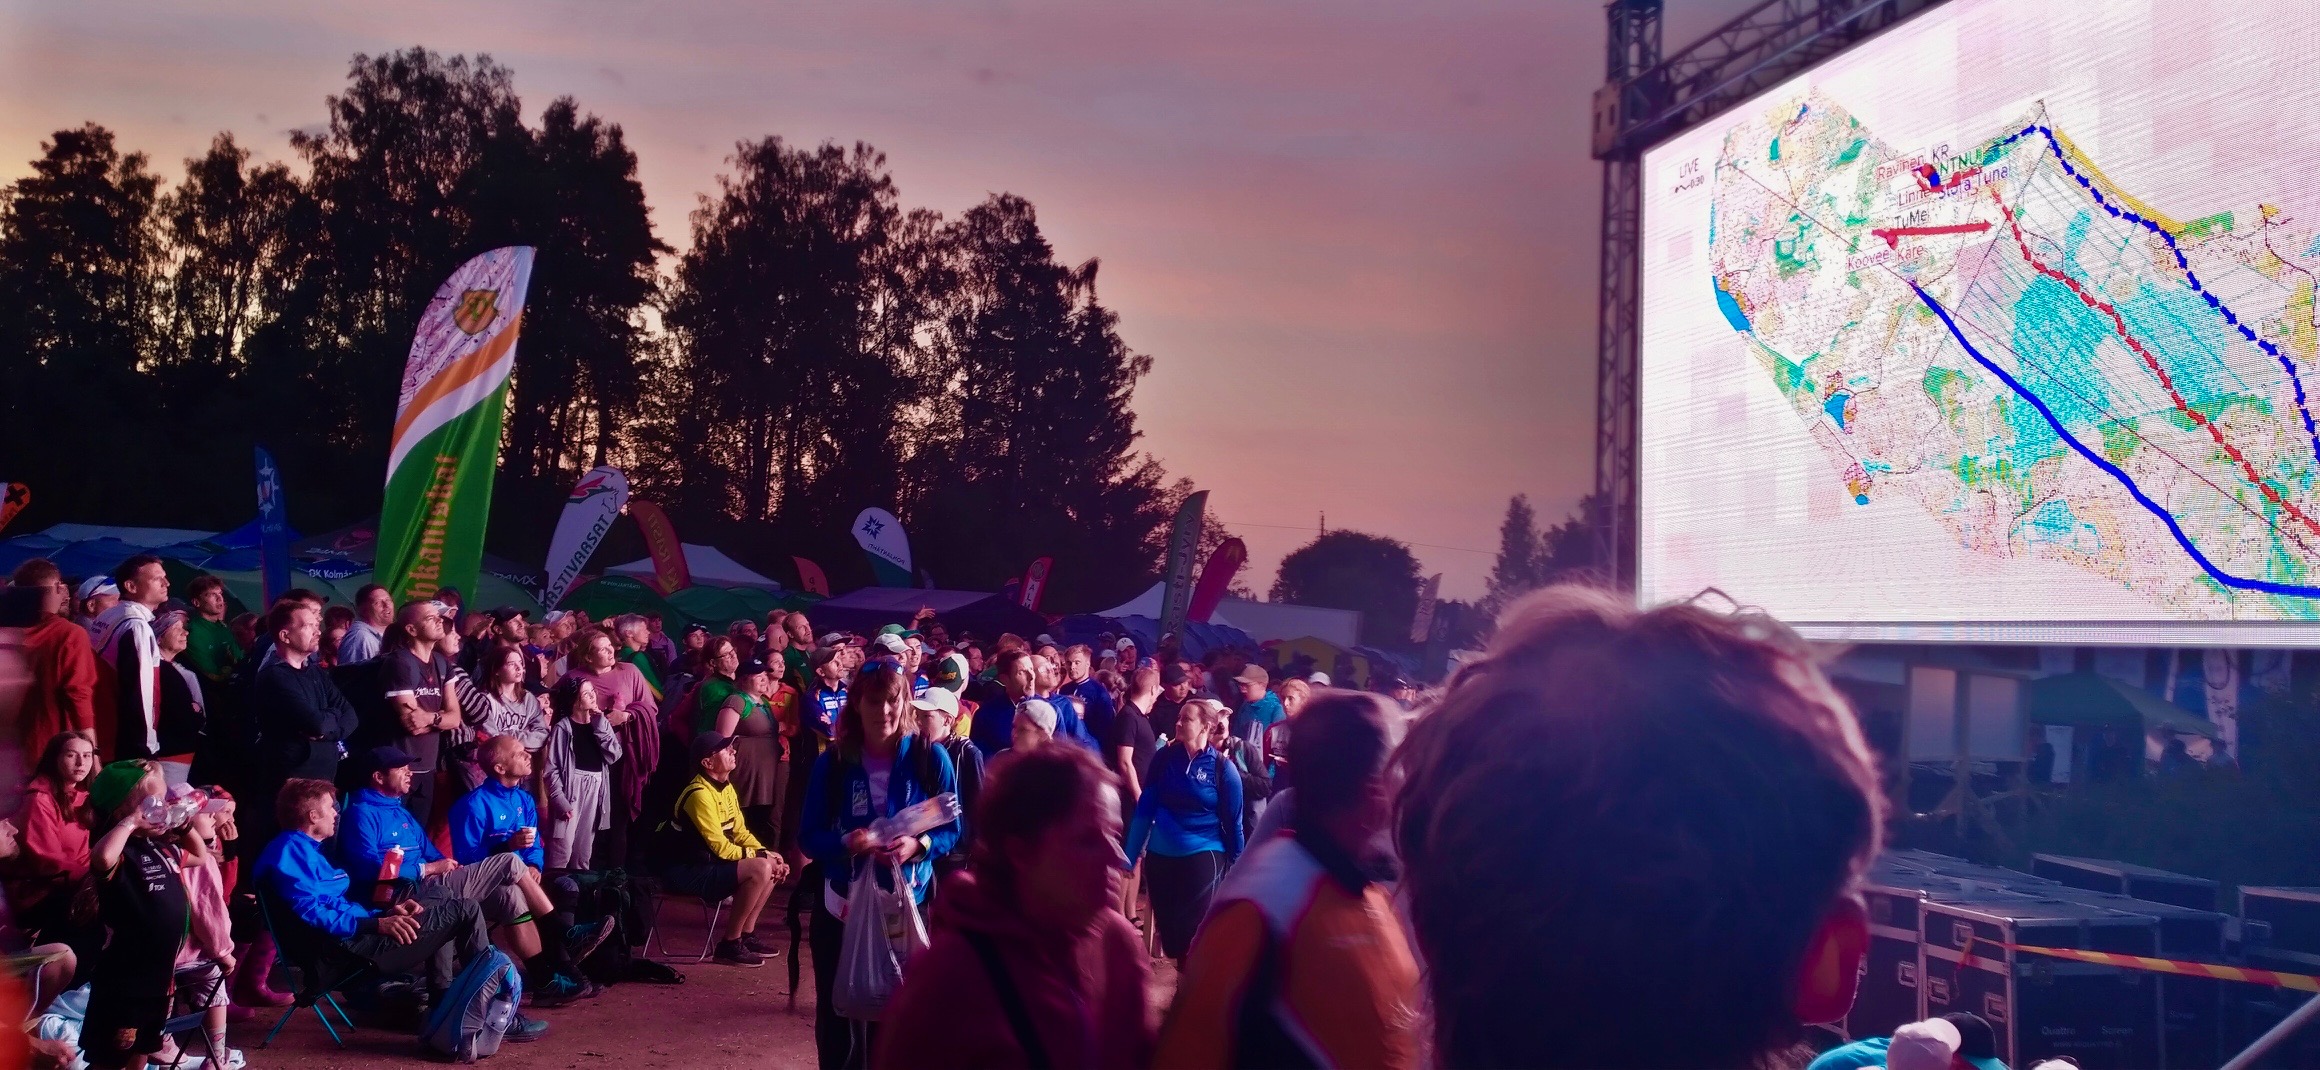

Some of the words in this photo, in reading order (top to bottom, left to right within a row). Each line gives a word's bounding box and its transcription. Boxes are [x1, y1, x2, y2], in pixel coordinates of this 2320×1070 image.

[1932, 143, 1949, 162] KR
[1940, 148, 1983, 175] NTNU
[1679, 157, 1699, 178] LIVE
[1877, 155, 1924, 181] Ravinen
[1894, 209, 1928, 229] TuMe
[1847, 249, 1890, 271] Koovee
